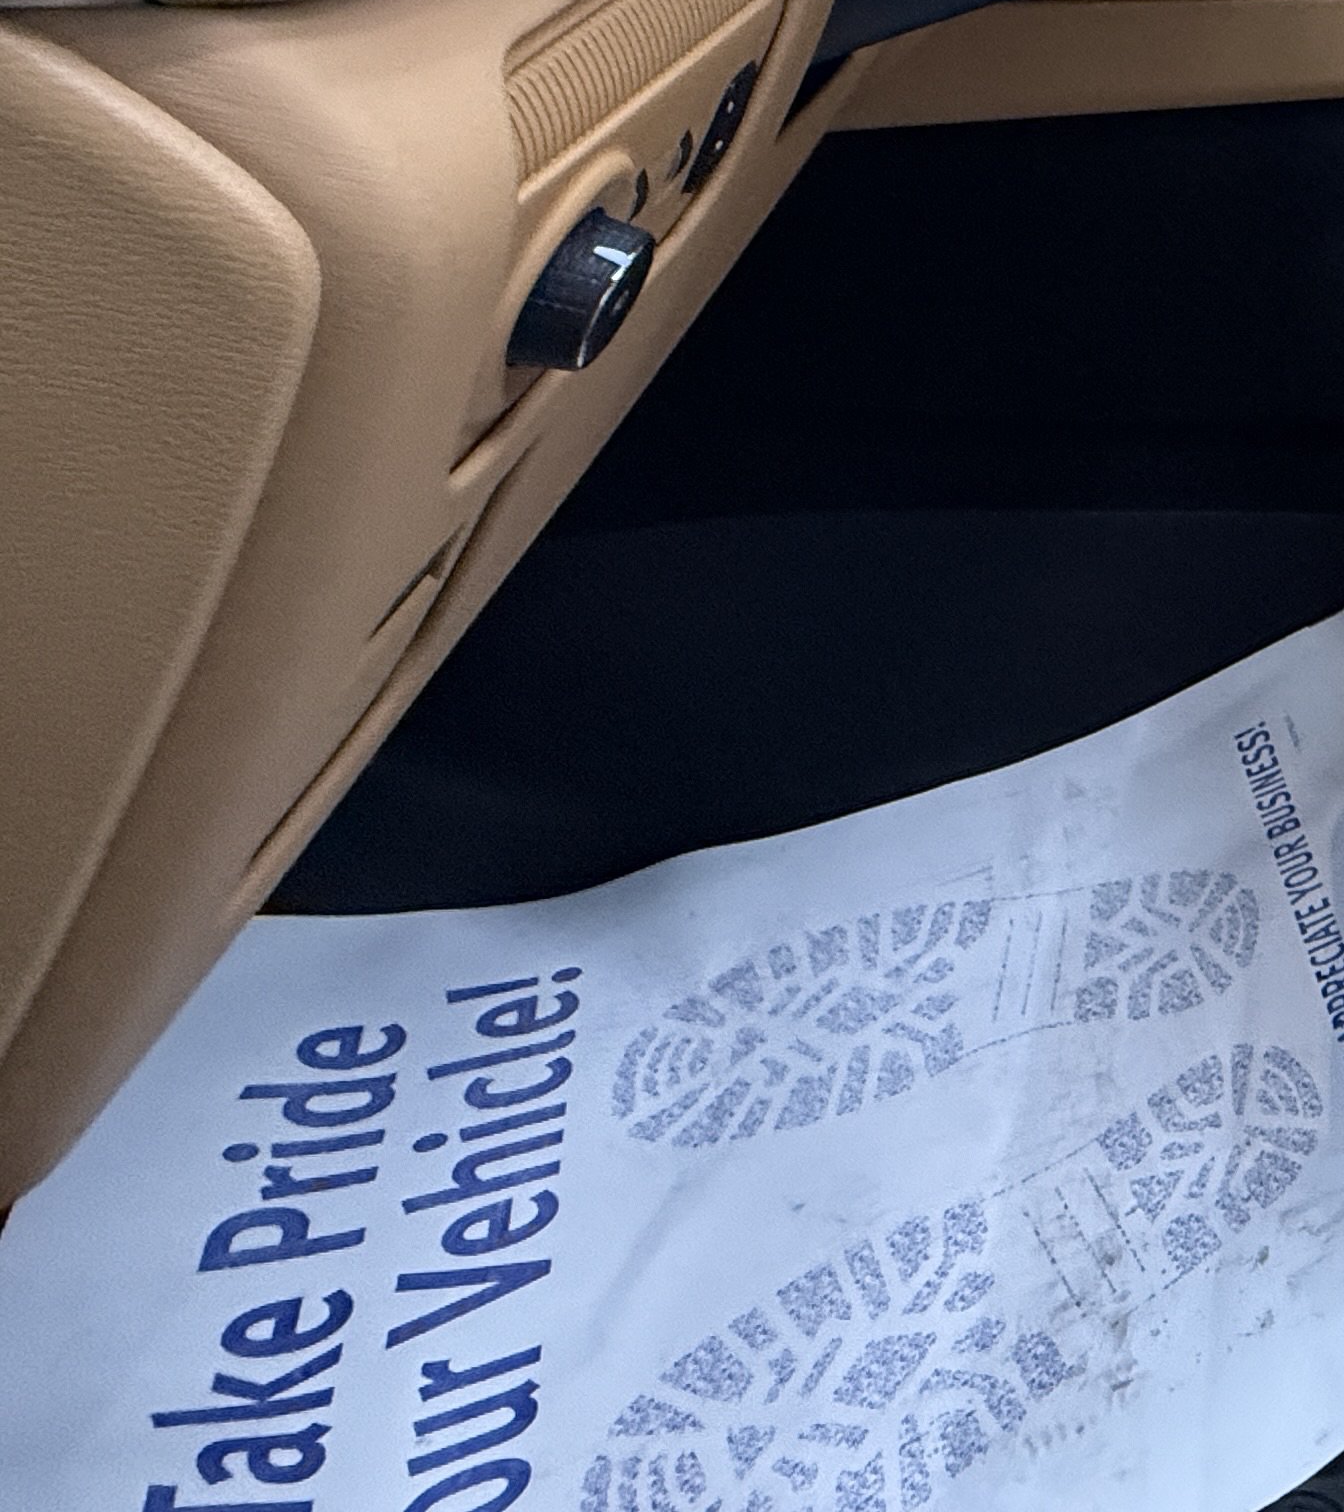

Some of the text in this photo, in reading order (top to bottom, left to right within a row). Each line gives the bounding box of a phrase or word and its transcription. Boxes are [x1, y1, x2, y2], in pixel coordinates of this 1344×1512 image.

[1234, 720, 1301, 840] BUSINESS!
[1274, 834, 1323, 906] YOUR
[142, 1023, 407, 1512] Take Pride
[386, 966, 583, 1512] our Vehicle!
